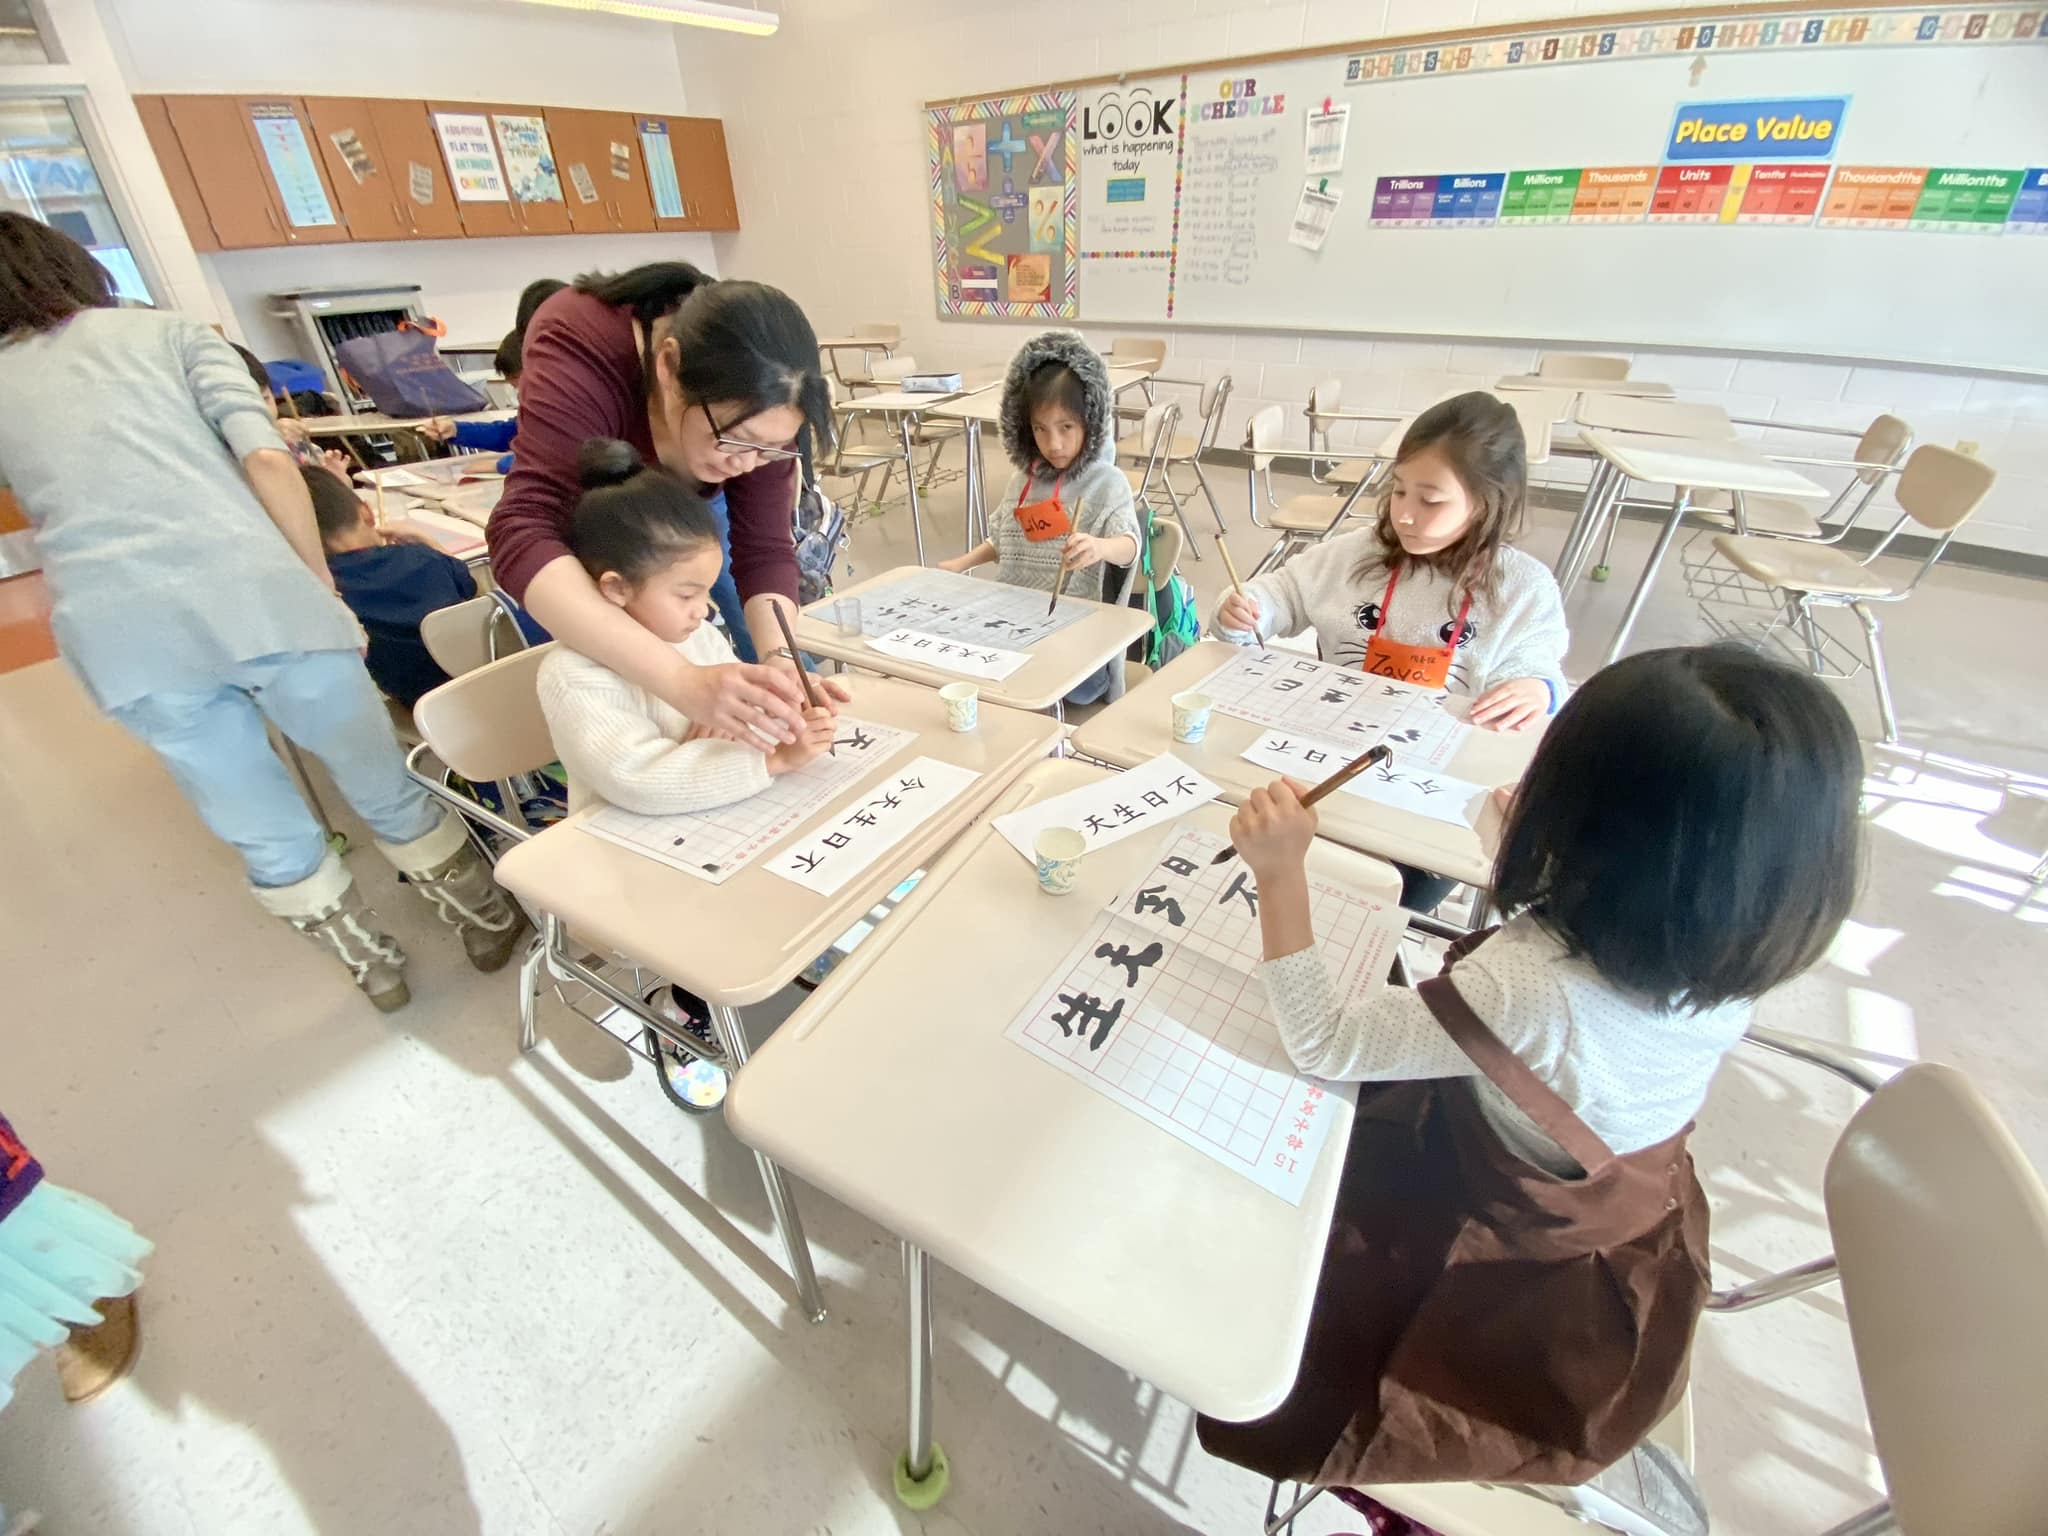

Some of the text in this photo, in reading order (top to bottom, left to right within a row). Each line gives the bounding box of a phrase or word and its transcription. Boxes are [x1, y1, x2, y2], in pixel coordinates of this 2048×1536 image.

[1219, 78, 1257, 99] OUR
[1190, 94, 1285, 123] SCHEDULE
[1083, 98, 1176, 140] LOOK
[1675, 114, 1833, 144] Place Value
[1083, 140, 1174, 157] what is happening
[1113, 159, 1141, 175] today
[1523, 174, 1564, 185] Millions
[1588, 170, 1648, 183] Thousands
[1679, 169, 1712, 181] Units
[1754, 169, 1786, 180] Tenths
[1838, 171, 1923, 185] Thousandths
[1938, 173, 2008, 187] Millionths
[1390, 179, 1424, 190] Trillions
[1453, 178, 1487, 188] Billions
[1273, 1151, 1299, 1174] 15
